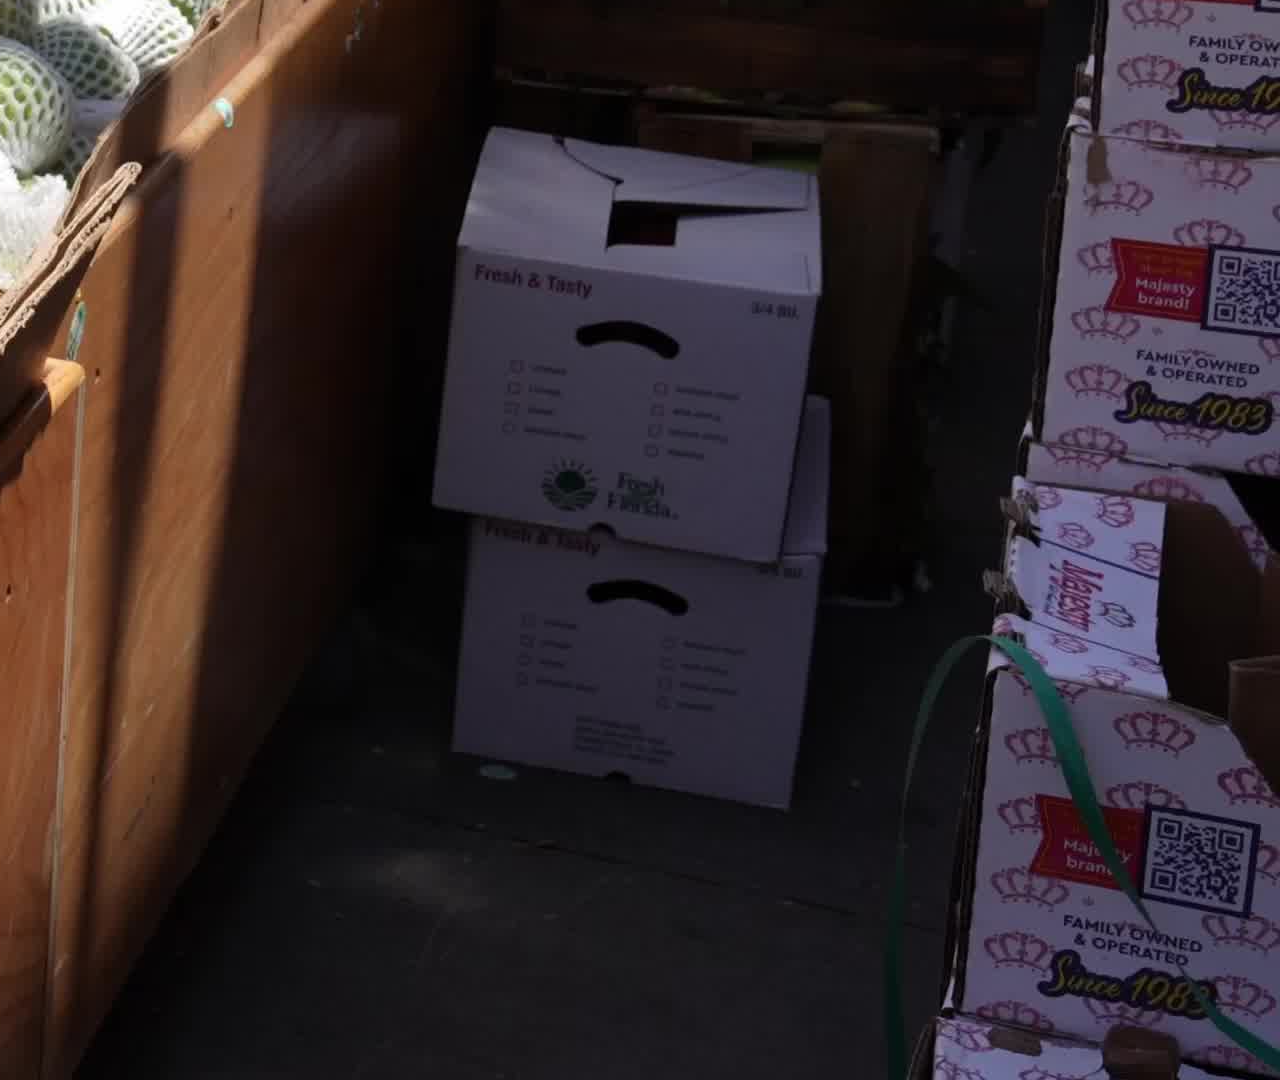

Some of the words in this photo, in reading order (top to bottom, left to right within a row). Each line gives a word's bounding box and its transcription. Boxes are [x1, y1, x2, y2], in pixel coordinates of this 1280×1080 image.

[1189, 36, 1245, 51] FAMILY
[1199, 52, 1210, 63] &
[1172, 69, 1244, 110] Since
[474, 264, 522, 287] Fresh
[527, 272, 542, 289] &
[546, 274, 593, 298] Tasty
[1135, 276, 1196, 297] Majesty
[1137, 292, 1191, 311] brand!
[1136, 349, 1192, 366] FAMILY
[1195, 357, 1260, 376] OWNED
[1146, 366, 1157, 377] &
[1162, 367, 1248, 389] OPERATED
[1119, 382, 1190, 421] Since
[1197, 394, 1270, 433] 1983
[1066, 855, 1113, 876] bran
[1063, 915, 1126, 938] FAMILY
[1130, 927, 1203, 953] OWNED
[1074, 934, 1086, 946] &
[1091, 937, 1189, 966] OPERATED
[1043, 952, 1123, 999] Since
